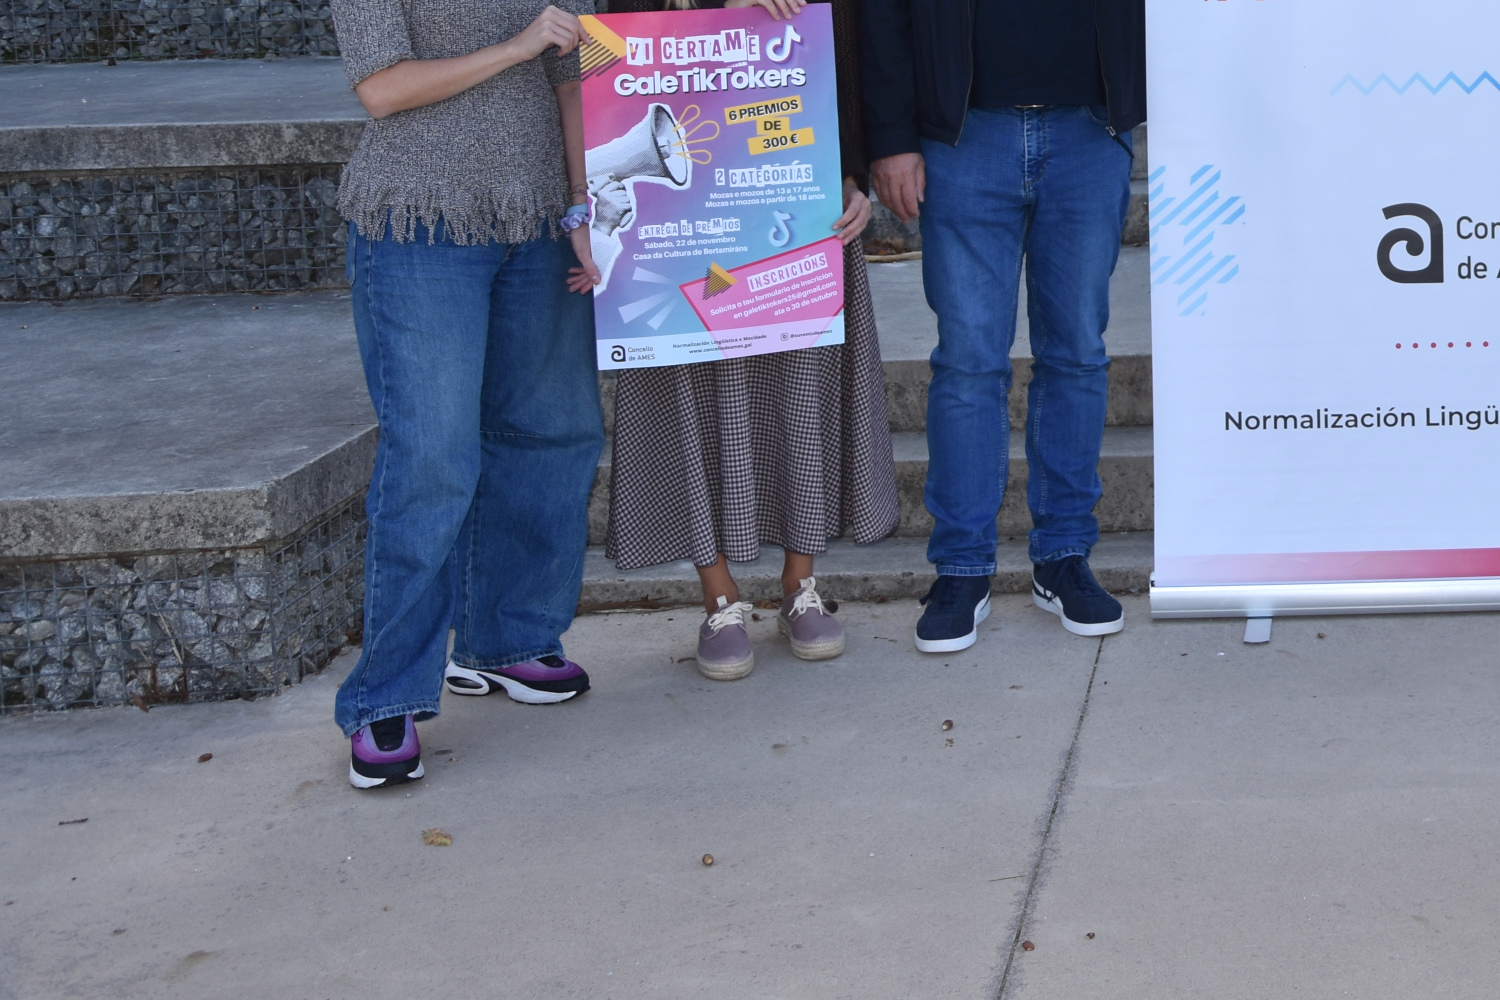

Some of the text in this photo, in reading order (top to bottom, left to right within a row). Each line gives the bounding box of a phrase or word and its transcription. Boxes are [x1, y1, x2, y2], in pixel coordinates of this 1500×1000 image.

[627, 30, 758, 61] VI CERTAME
[614, 66, 806, 96] GaleTikTokers
[729, 100, 799, 121] 6 PREMIOS
[764, 121, 781, 131] DE
[763, 134, 798, 149] 300 €
[716, 170, 724, 183] 2
[766, 196, 786, 204] partir
[639, 219, 740, 237] ENTREGA DE PREMIOS
[644, 241, 674, 249] Sábado,
[664, 250, 691, 258] Cultura
[704, 246, 748, 255] Bertamiráns
[1458, 256, 1488, 279] de
[710, 304, 736, 315] Solicita
[755, 287, 790, 302] formulario
[811, 290, 837, 303] outubro
[1224, 407, 1416, 431] Normalización
